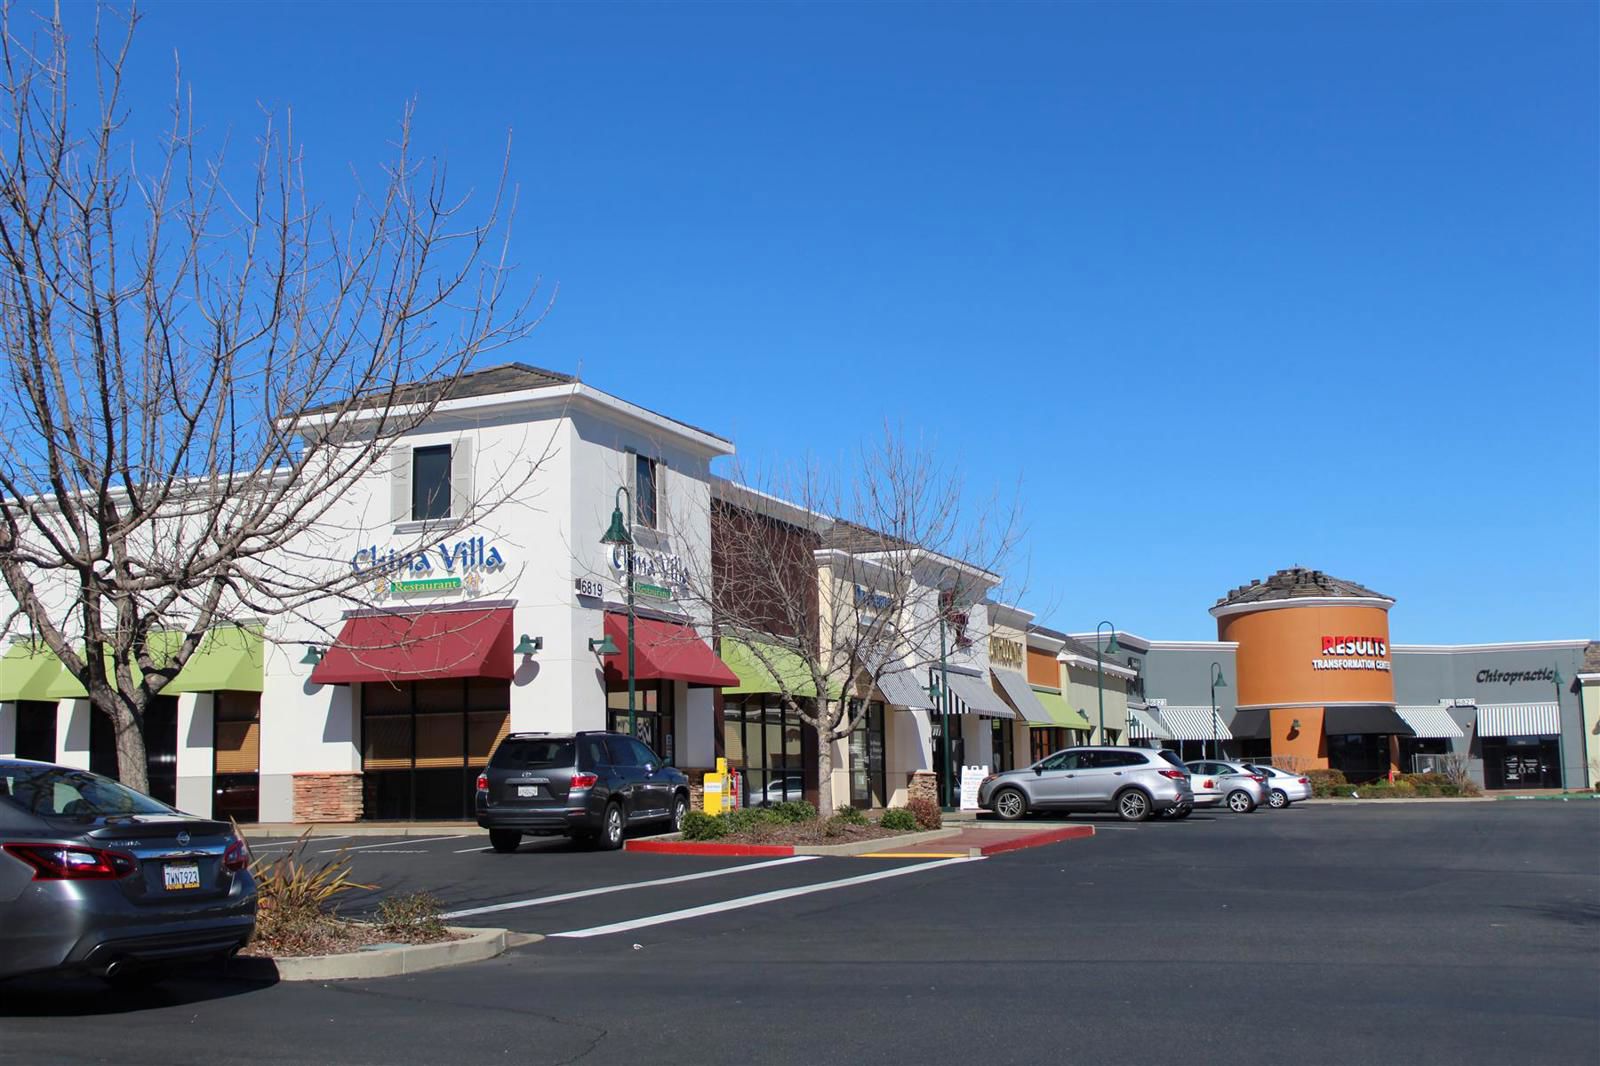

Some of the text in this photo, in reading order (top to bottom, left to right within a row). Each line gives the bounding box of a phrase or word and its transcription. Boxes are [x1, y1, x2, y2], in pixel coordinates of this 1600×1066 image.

[438, 536, 503, 573] Villa
[394, 580, 457, 592] Restaurant
[581, 581, 603, 597] 6819
[1322, 637, 1386, 656] RESULTS
[1312, 659, 1375, 670] TRANSFORMATION
[1476, 667, 1554, 686] Chiropractic
[165, 871, 198, 884] 7WNT923
